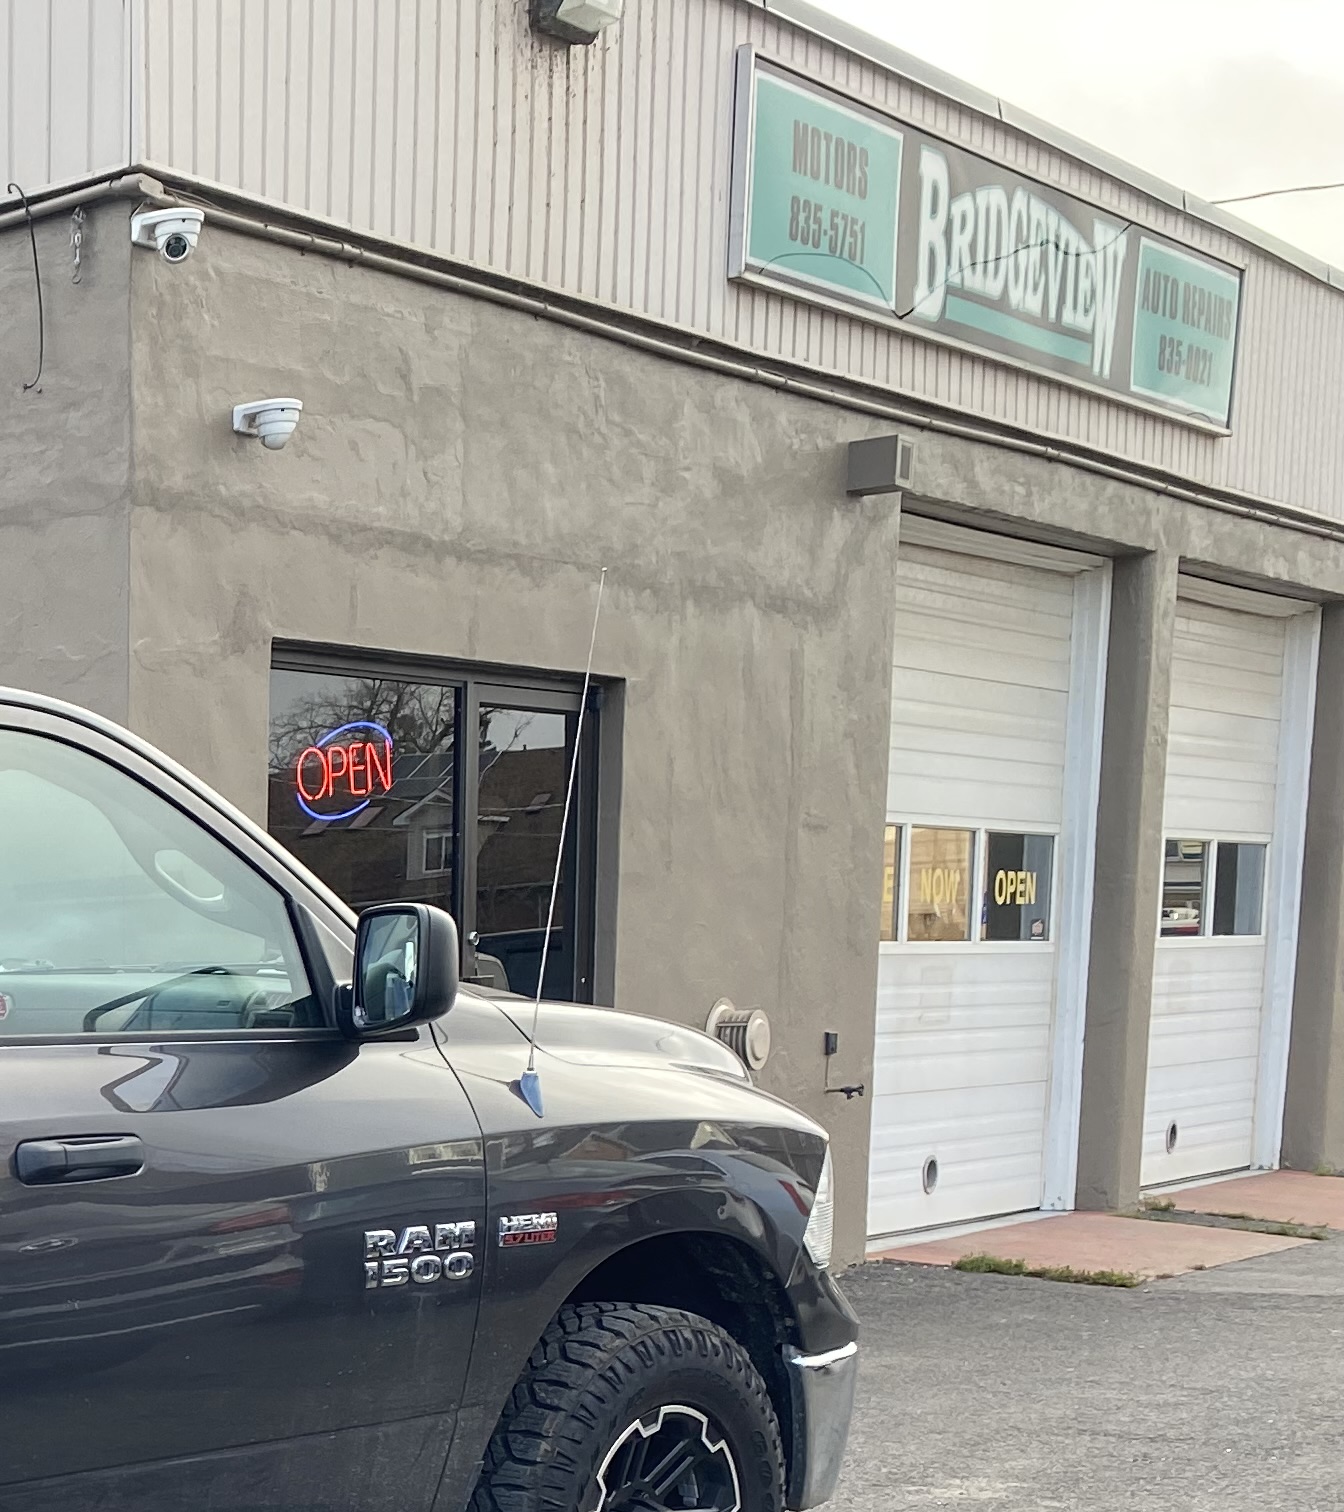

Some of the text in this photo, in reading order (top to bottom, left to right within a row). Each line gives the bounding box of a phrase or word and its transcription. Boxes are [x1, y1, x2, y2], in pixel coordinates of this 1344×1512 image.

[792, 119, 869, 201] MOTORS
[789, 195, 866, 265] 835-5751
[912, 144, 1128, 380] BRIDGEVIEW
[1141, 267, 1233, 341] AUTO REPAIRS
[297, 738, 393, 801] OPEN
[921, 867, 960, 904] NOW
[994, 869, 1037, 906] OPEN
[364, 1220, 476, 1258] RAM
[364, 1250, 475, 1289] 1500
